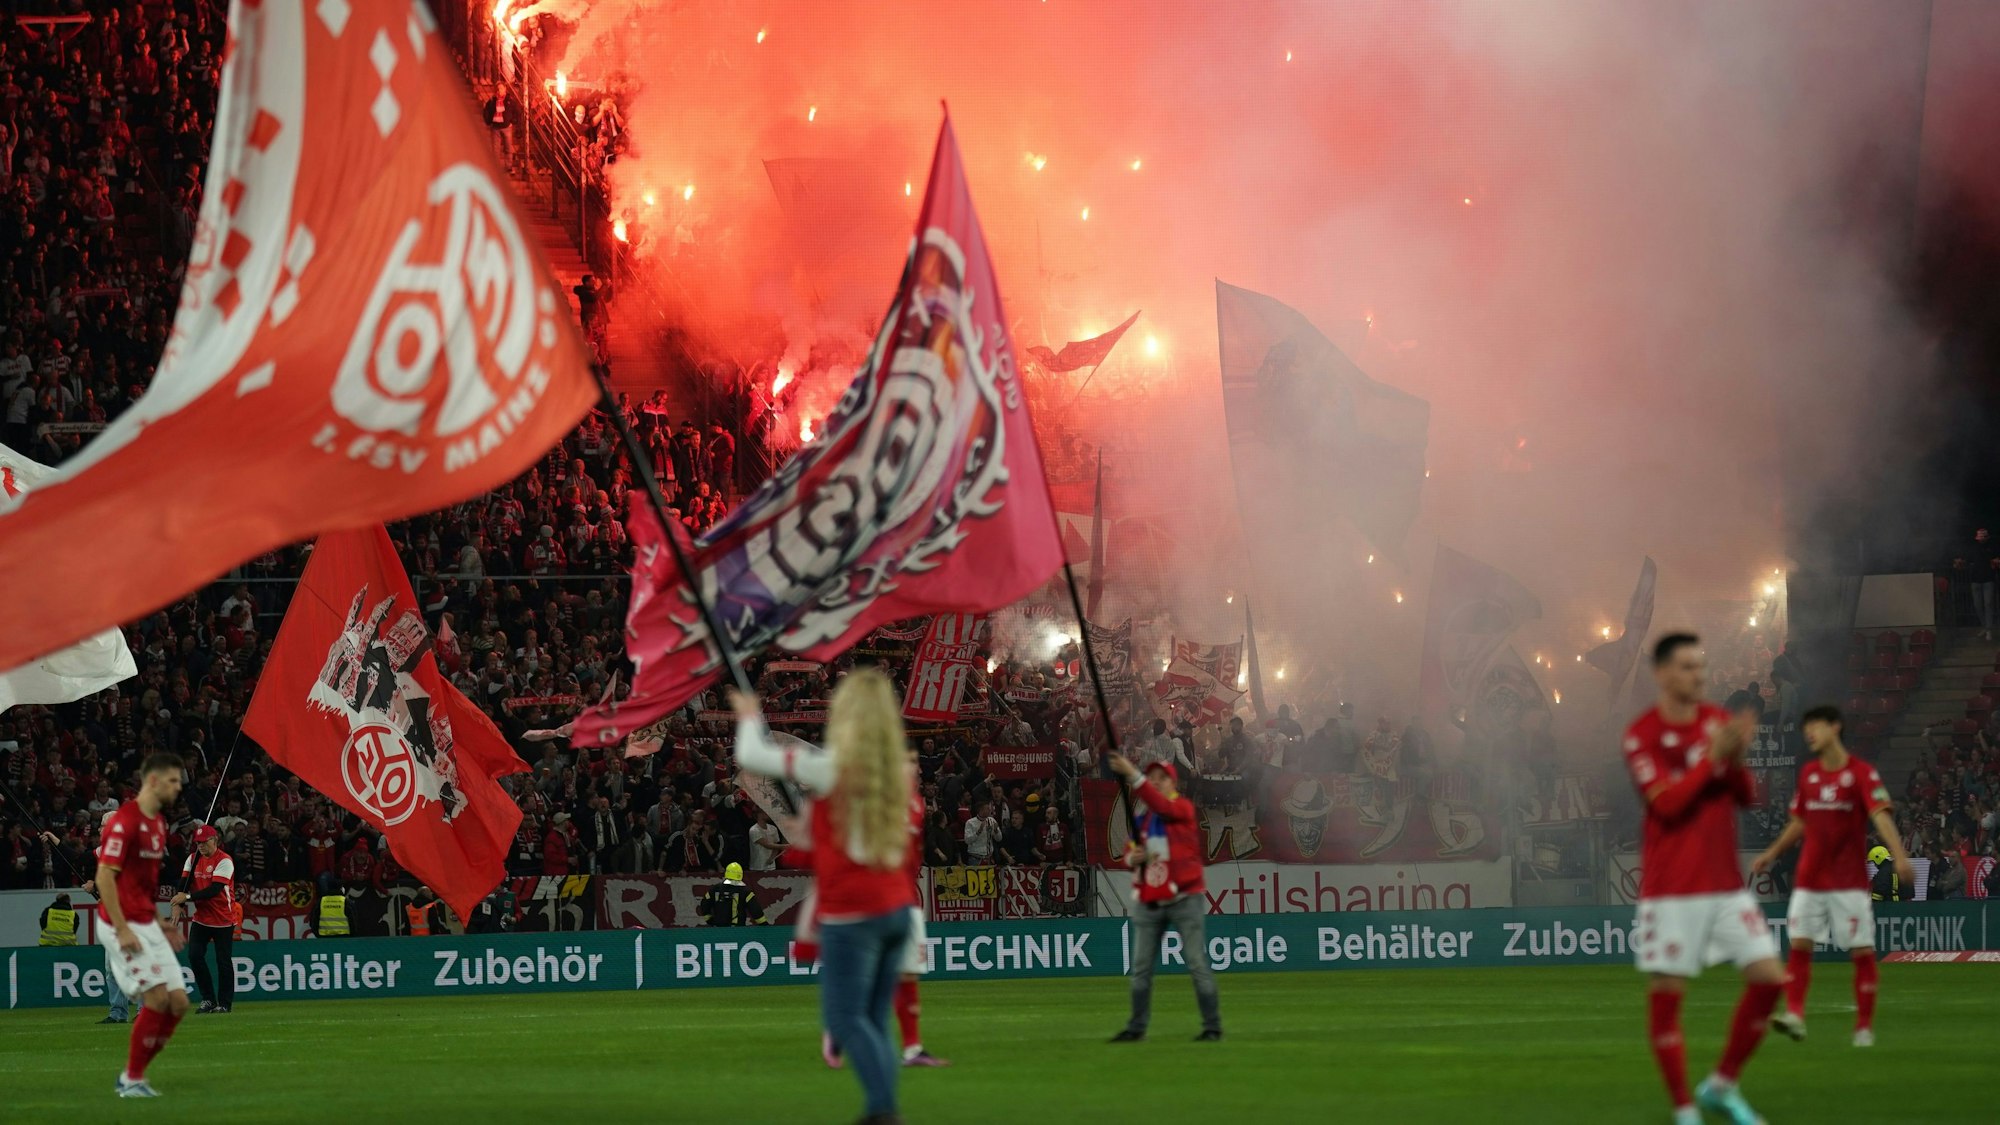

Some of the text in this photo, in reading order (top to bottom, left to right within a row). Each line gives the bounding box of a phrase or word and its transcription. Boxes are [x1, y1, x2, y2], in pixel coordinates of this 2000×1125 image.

[346, 434, 428, 475] FSV
[444, 363, 551, 473] MAINZ
[987, 752, 1053, 764] HÖHER JUNGS
[1012, 763, 1028, 772] 2013
[250, 887, 287, 906] 2012
[1205, 871, 1472, 915] xtilsharing
[53, 961, 196, 999] Ree
[233, 953, 401, 993] Behälter
[434, 945, 603, 987] Zubehör
[1161, 928, 1288, 971] Rgale
[1318, 924, 1473, 961] Behälter
[1503, 920, 1643, 957] Zubehö
